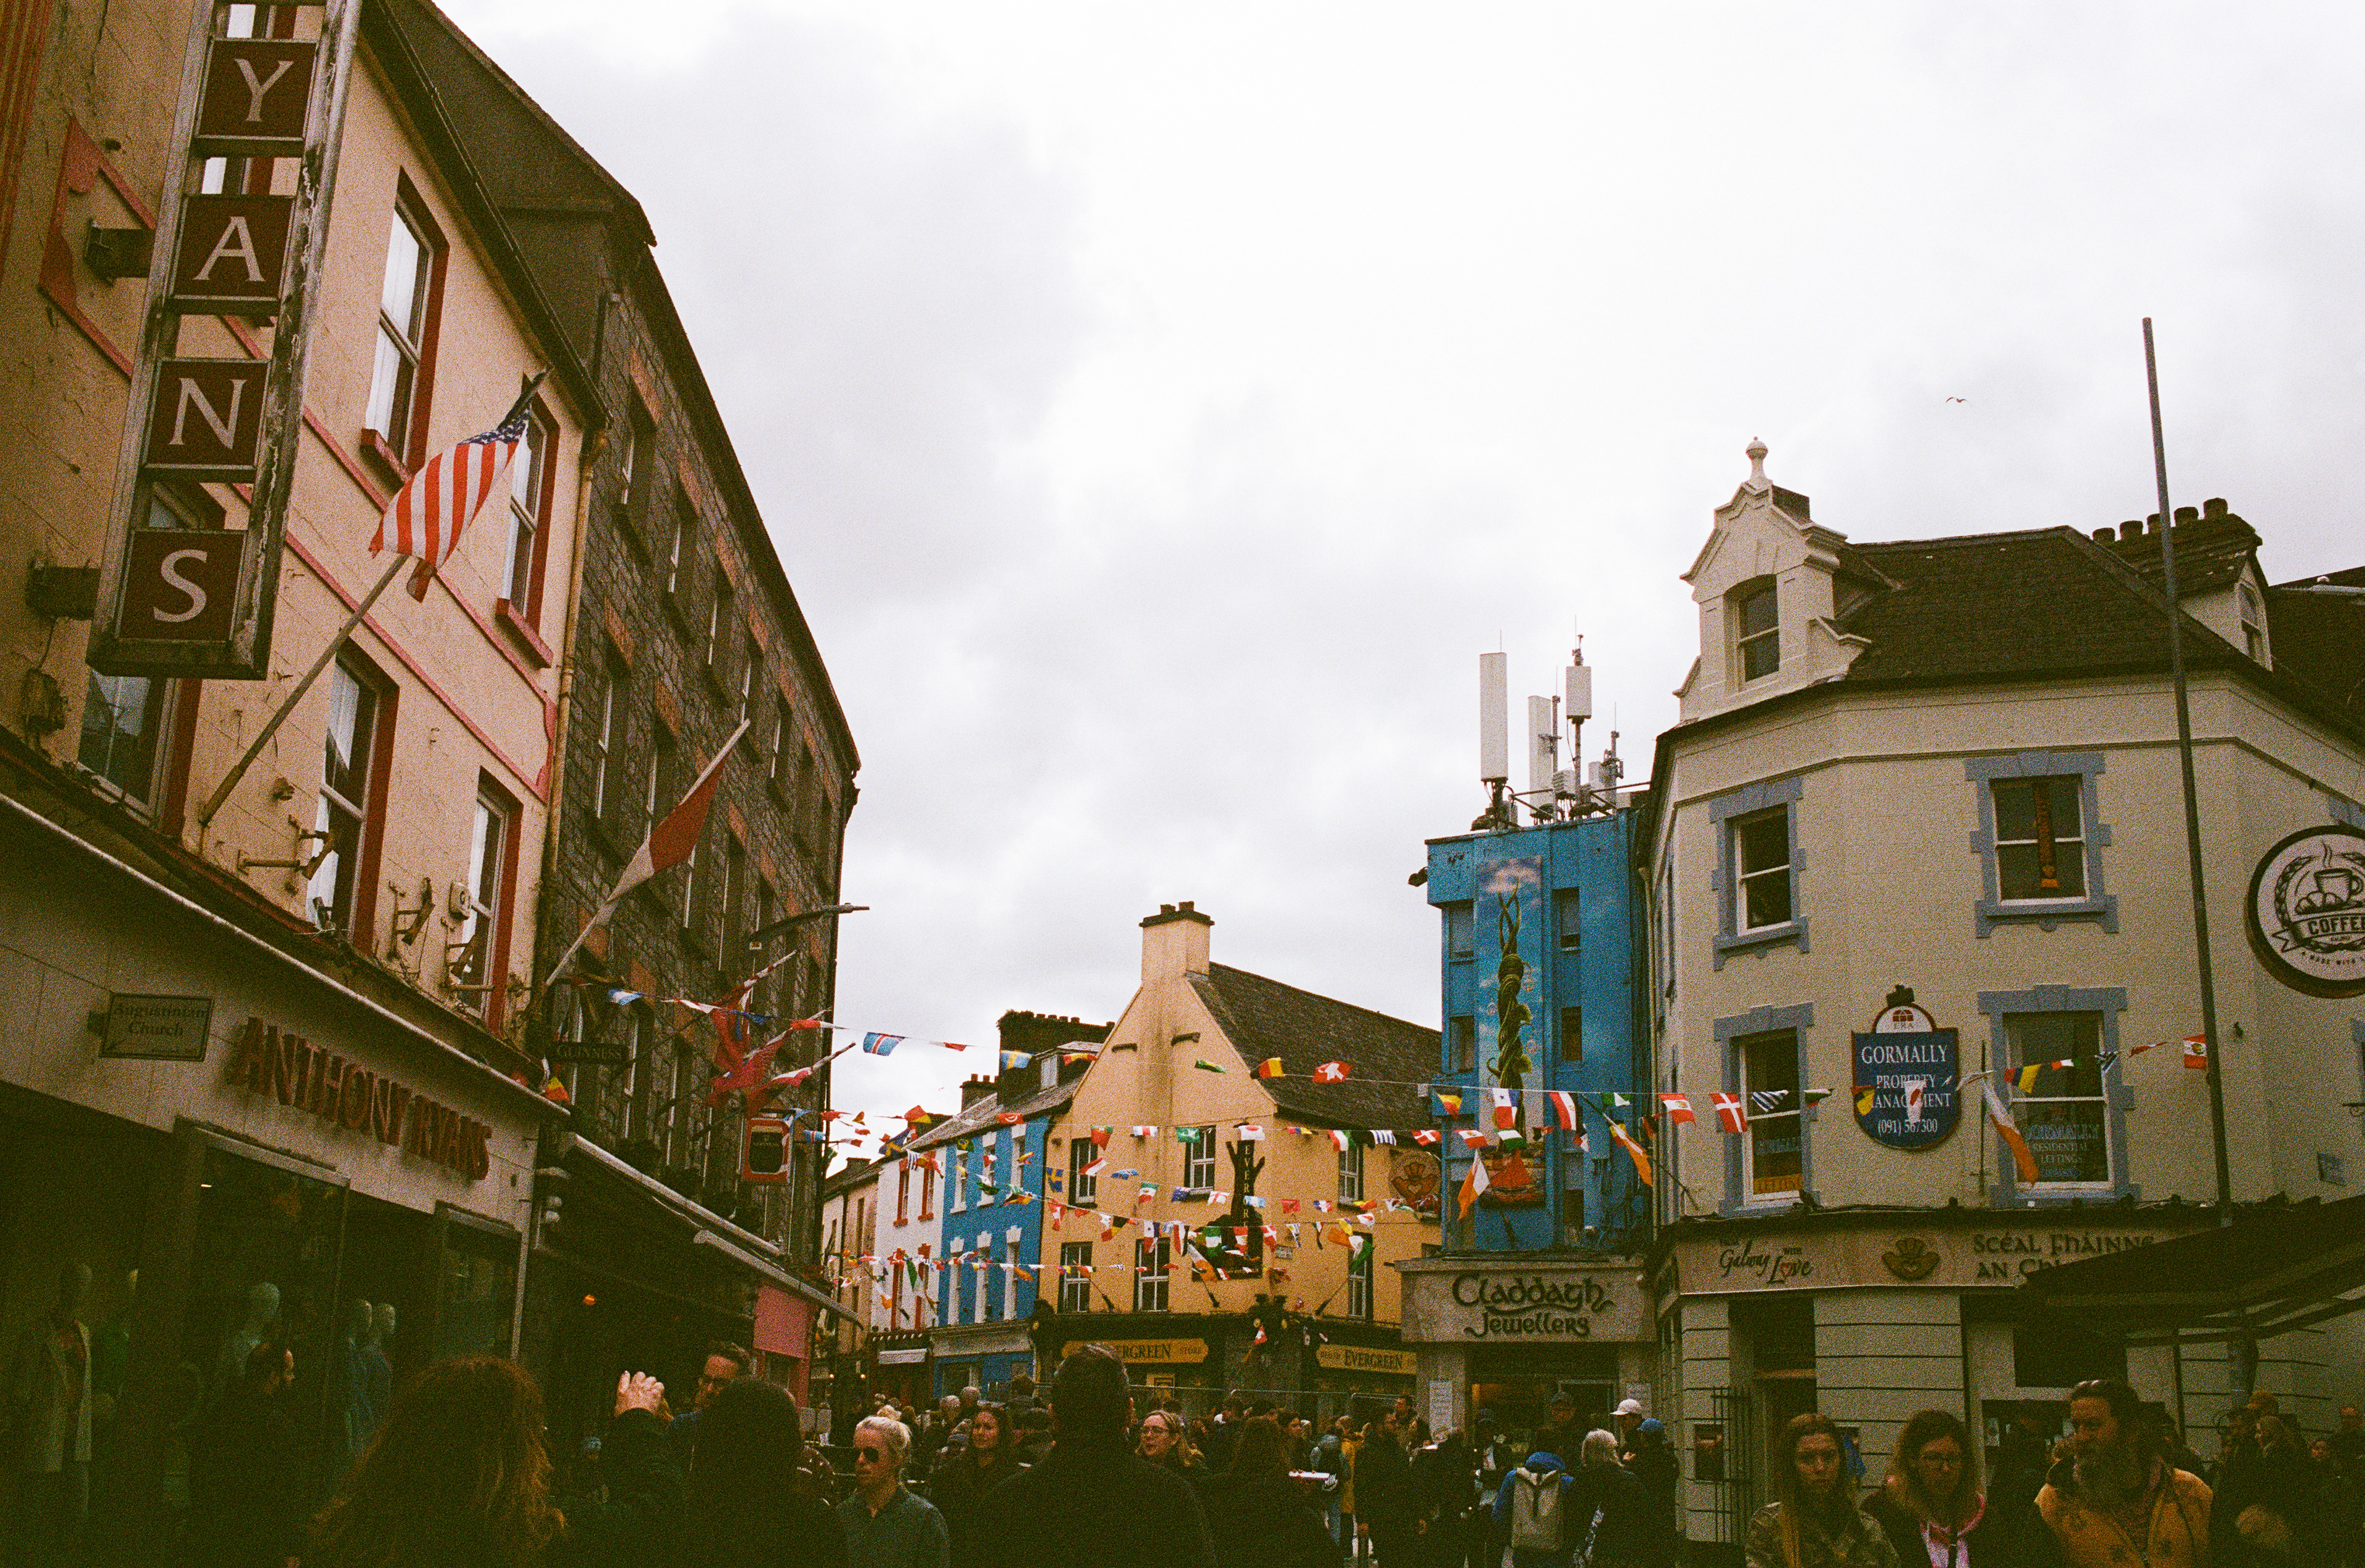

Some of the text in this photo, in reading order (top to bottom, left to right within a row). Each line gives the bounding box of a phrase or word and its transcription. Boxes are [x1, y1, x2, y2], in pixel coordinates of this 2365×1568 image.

[128, 1021, 184, 1036] Church
[1861, 1045, 1947, 1064] GORMALLY
[227, 1017, 411, 1147] ANTHONY
[1878, 1119, 1901, 1137] (091)
[1719, 1239, 1771, 1278] Galway
[1766, 1255, 1814, 1284] Love
[1976, 1261, 2008, 1279] AN
[1452, 1272, 1616, 1315] Claddagh
[1463, 1312, 1590, 1338] Jewellers
[1344, 1349, 1404, 1370] EVERGREEN
